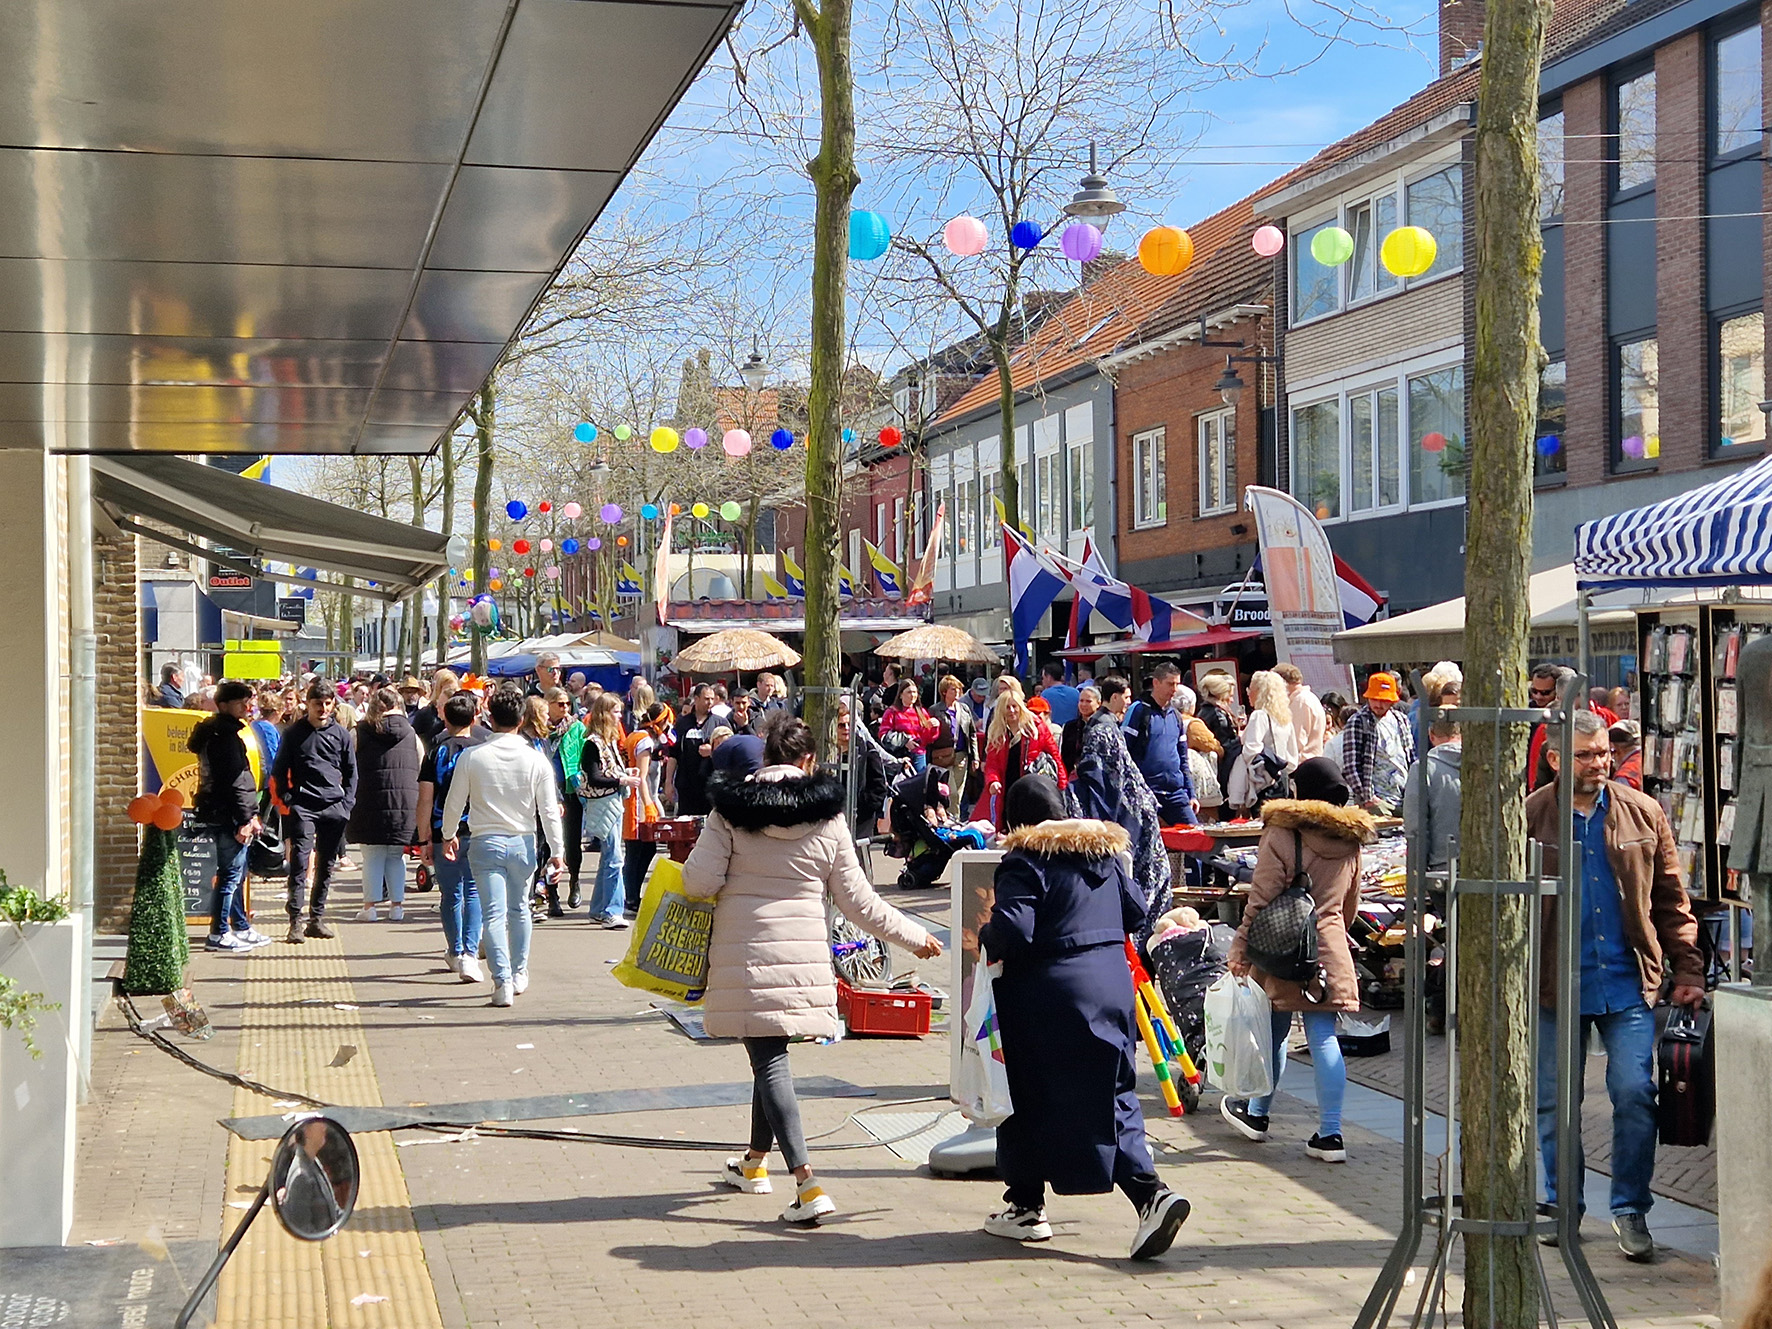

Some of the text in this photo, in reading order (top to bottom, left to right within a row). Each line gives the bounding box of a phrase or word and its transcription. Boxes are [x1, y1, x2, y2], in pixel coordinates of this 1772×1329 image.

[209, 576, 250, 586] Outlet
[1529, 631, 1560, 655] CAFÉ
[167, 724, 188, 739] beleef
[169, 740, 176, 752] in
[656, 921, 709, 953] SCHERPE
[646, 942, 705, 977] PRIJZEN
